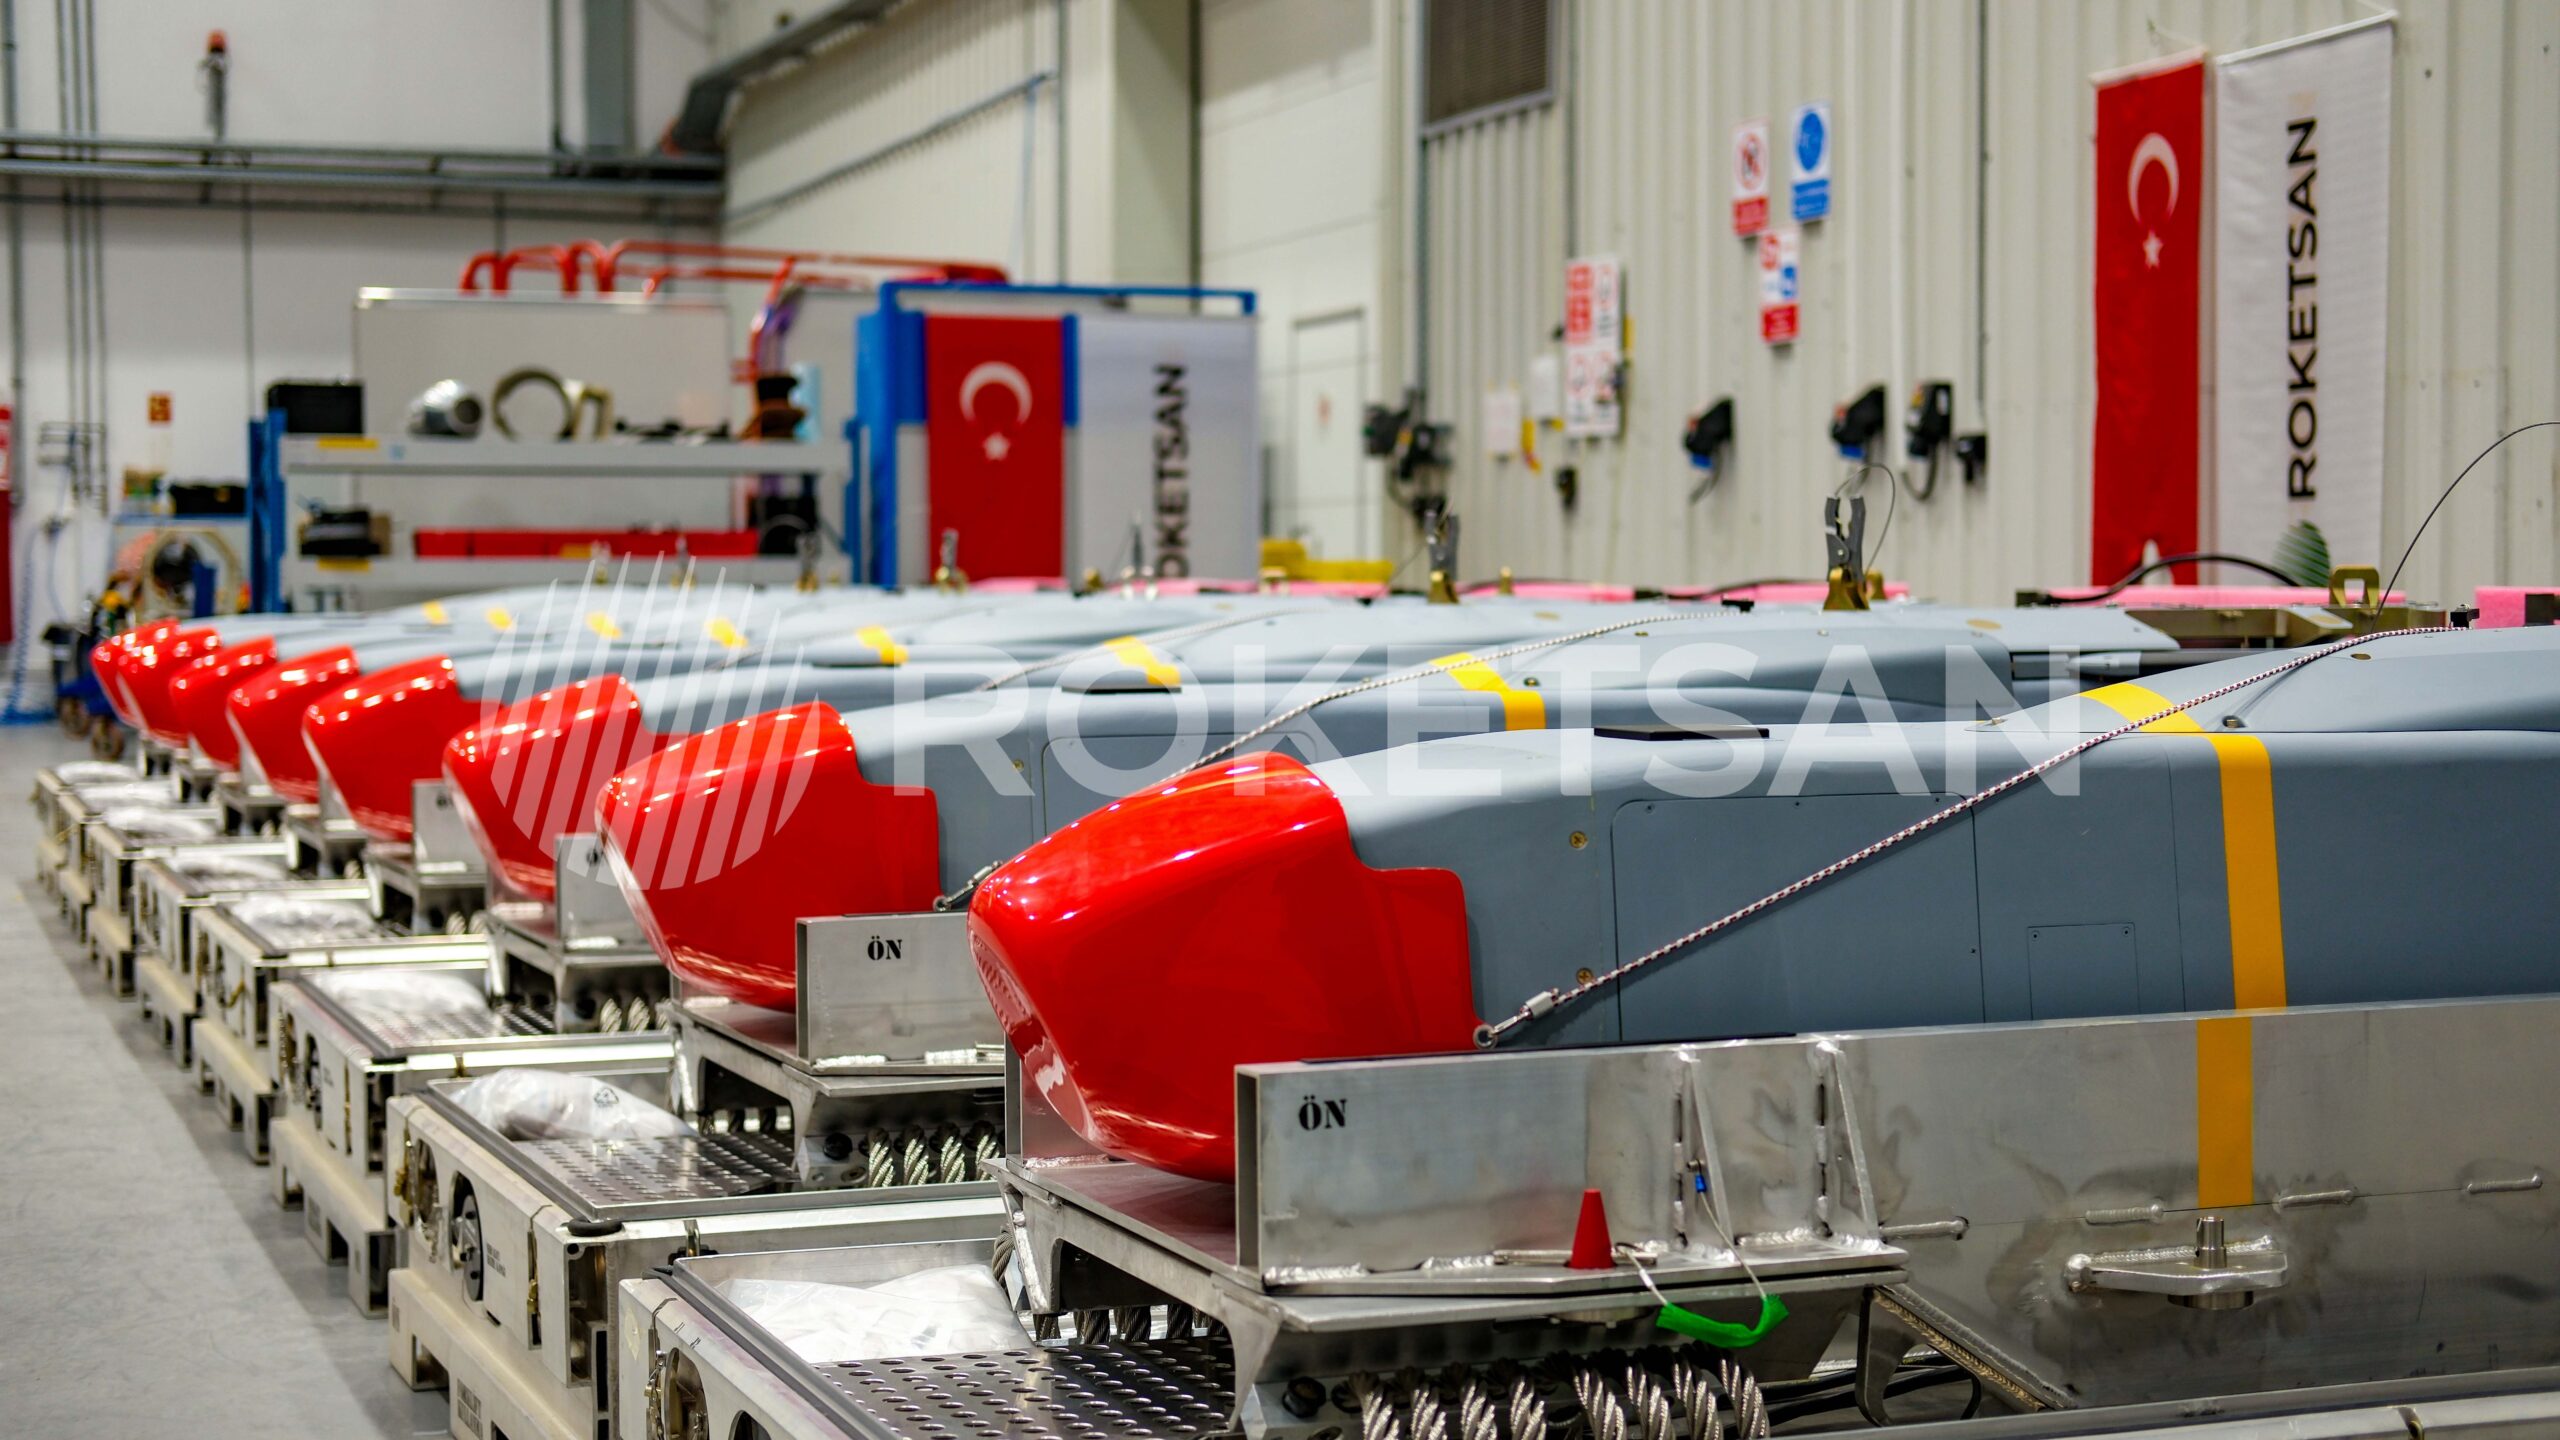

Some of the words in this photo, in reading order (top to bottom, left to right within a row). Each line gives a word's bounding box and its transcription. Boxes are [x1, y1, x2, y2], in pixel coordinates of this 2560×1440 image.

[2286, 116, 2319, 501] ROKETSAN
[1153, 363, 1190, 578] OKETSAN
[867, 935, 903, 961] ÖN
[1298, 1094, 1348, 1132] ÖN
